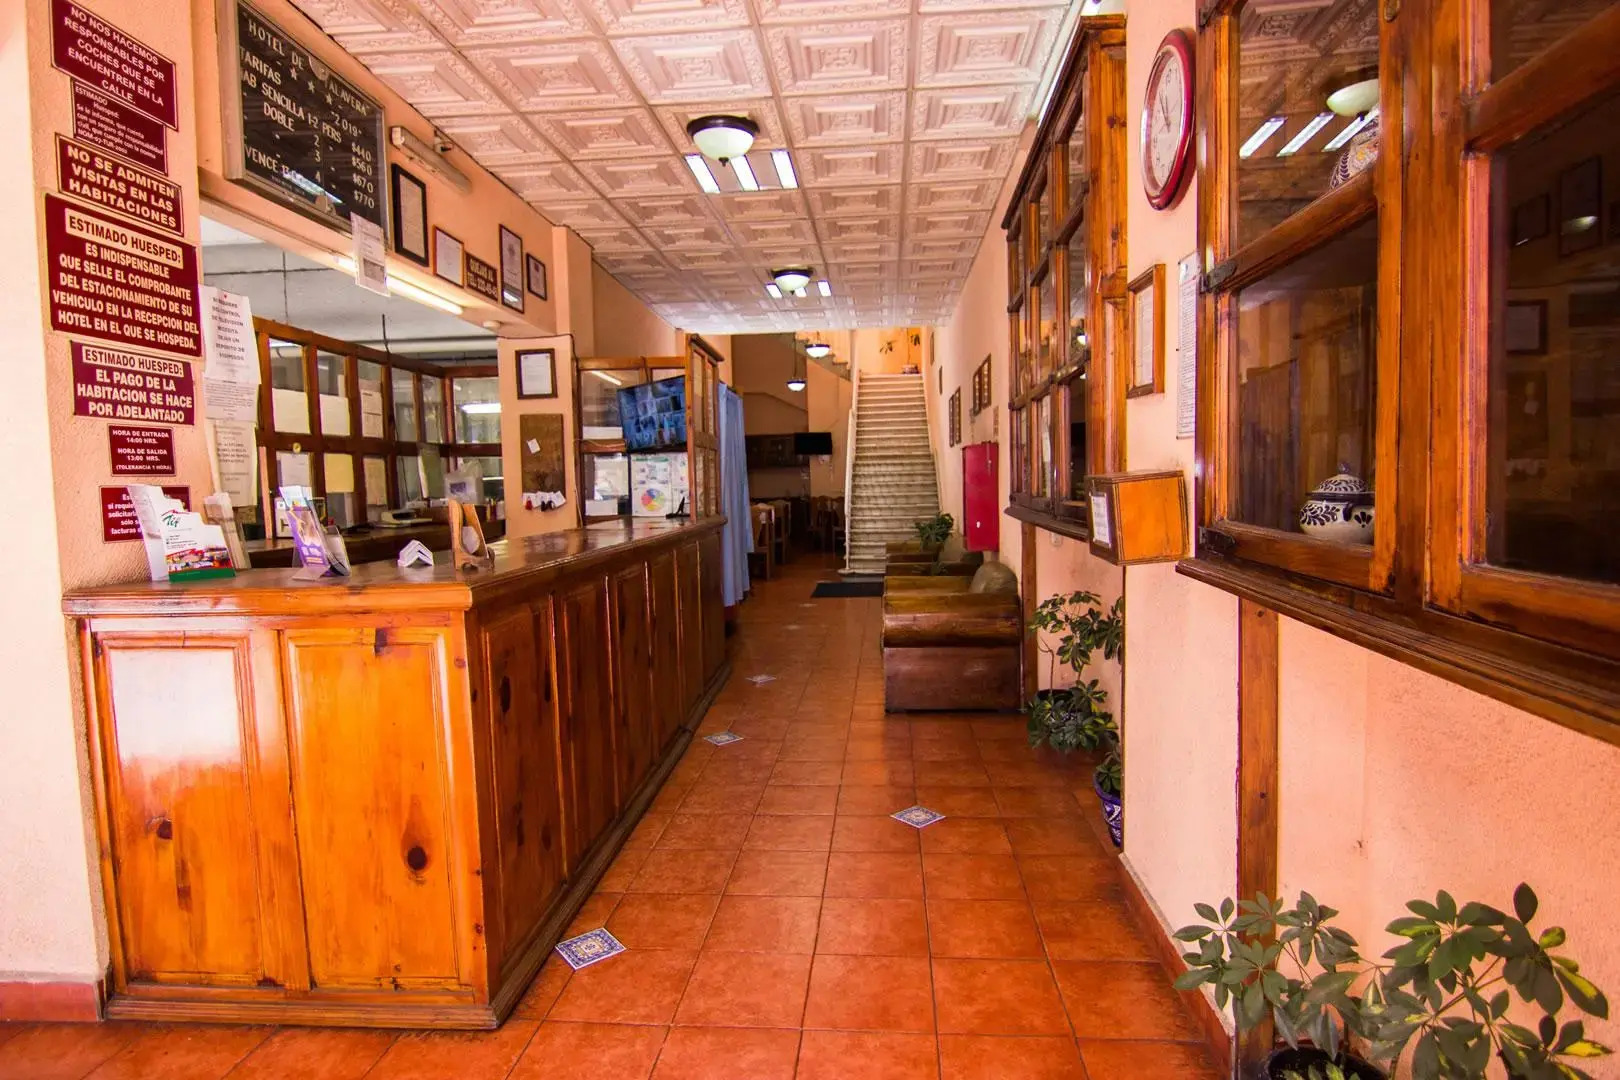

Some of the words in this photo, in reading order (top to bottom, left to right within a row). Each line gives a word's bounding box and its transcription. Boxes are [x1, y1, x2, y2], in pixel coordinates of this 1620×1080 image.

[64, 17, 144, 69] RESPONSABLES
[146, 65, 165, 82] POR
[71, 7, 86, 22] NO
[90, 18, 110, 36] NOS
[113, 32, 158, 66] HACEMOS
[68, 48, 136, 91] ENCUENTREN
[138, 86, 150, 98] EN
[152, 94, 164, 106] LA
[77, 39, 120, 68] COCHES
[122, 64, 142, 80] QUE
[144, 76, 155, 88] SE
[240, 46, 281, 85] TARIFAS
[292, 52, 304, 70] DE
[76, 86, 108, 105] ESTIMADO
[102, 80, 136, 104] CALLE.
[242, 69, 257, 88] AB
[262, 82, 304, 119] SENCILLA
[308, 113, 318, 128] 1-2
[322, 122, 341, 143] PERS
[352, 142, 371, 161] $440
[245, 144, 278, 173] VENCE
[264, 102, 294, 132] DOBLE
[314, 134, 319, 147] 2
[352, 155, 372, 176] $560
[67, 145, 90, 164] NO
[94, 157, 113, 173] SE
[117, 166, 175, 199] ADMITEN
[72, 163, 126, 194] VISITAS
[130, 187, 147, 202] EN
[151, 195, 173, 212] LAS
[316, 150, 320, 162] 3
[353, 173, 373, 193] $670
[316, 170, 320, 183] 4
[354, 190, 374, 208] $770
[69, 179, 176, 228] HABITACIONES
[69, 216, 128, 246] ESTIMADO
[131, 236, 181, 264] HUESPED:
[86, 243, 98, 257] ES
[100, 248, 169, 278] INDISPENSABLE
[60, 254, 81, 271] QUE
[84, 260, 113, 280] SELLE
[115, 270, 126, 283] EL
[128, 274, 191, 300] COMPROBANTE
[60, 272, 80, 289] DEL
[82, 279, 167, 311] ESTACIONAMIENTO
[169, 303, 180, 314] DE
[181, 305, 192, 317] SU
[53, 289, 103, 313] VEHICULO
[106, 303, 119, 316] EN
[121, 306, 132, 320] LA
[135, 309, 182, 331] RECEPCION
[184, 322, 199, 334] DEL
[59, 311, 92, 329] HOTEL
[94, 319, 107, 332] EN
[110, 322, 121, 334] EL
[123, 325, 142, 339] QUE
[144, 330, 155, 340] SE
[157, 332, 196, 349] HOSPEDA.
[85, 349, 136, 367] ESTIMADO
[138, 359, 183, 375] HUESPED:
[96, 369, 110, 382] EL
[113, 371, 143, 388] PAGO
[146, 376, 160, 389] DE
[162, 378, 176, 391] LA
[77, 383, 146, 404] HABITACION
[150, 392, 163, 404] SE
[166, 393, 192, 408] HACE
[88, 402, 113, 416] POR
[116, 404, 184, 422] ADELANTADO
